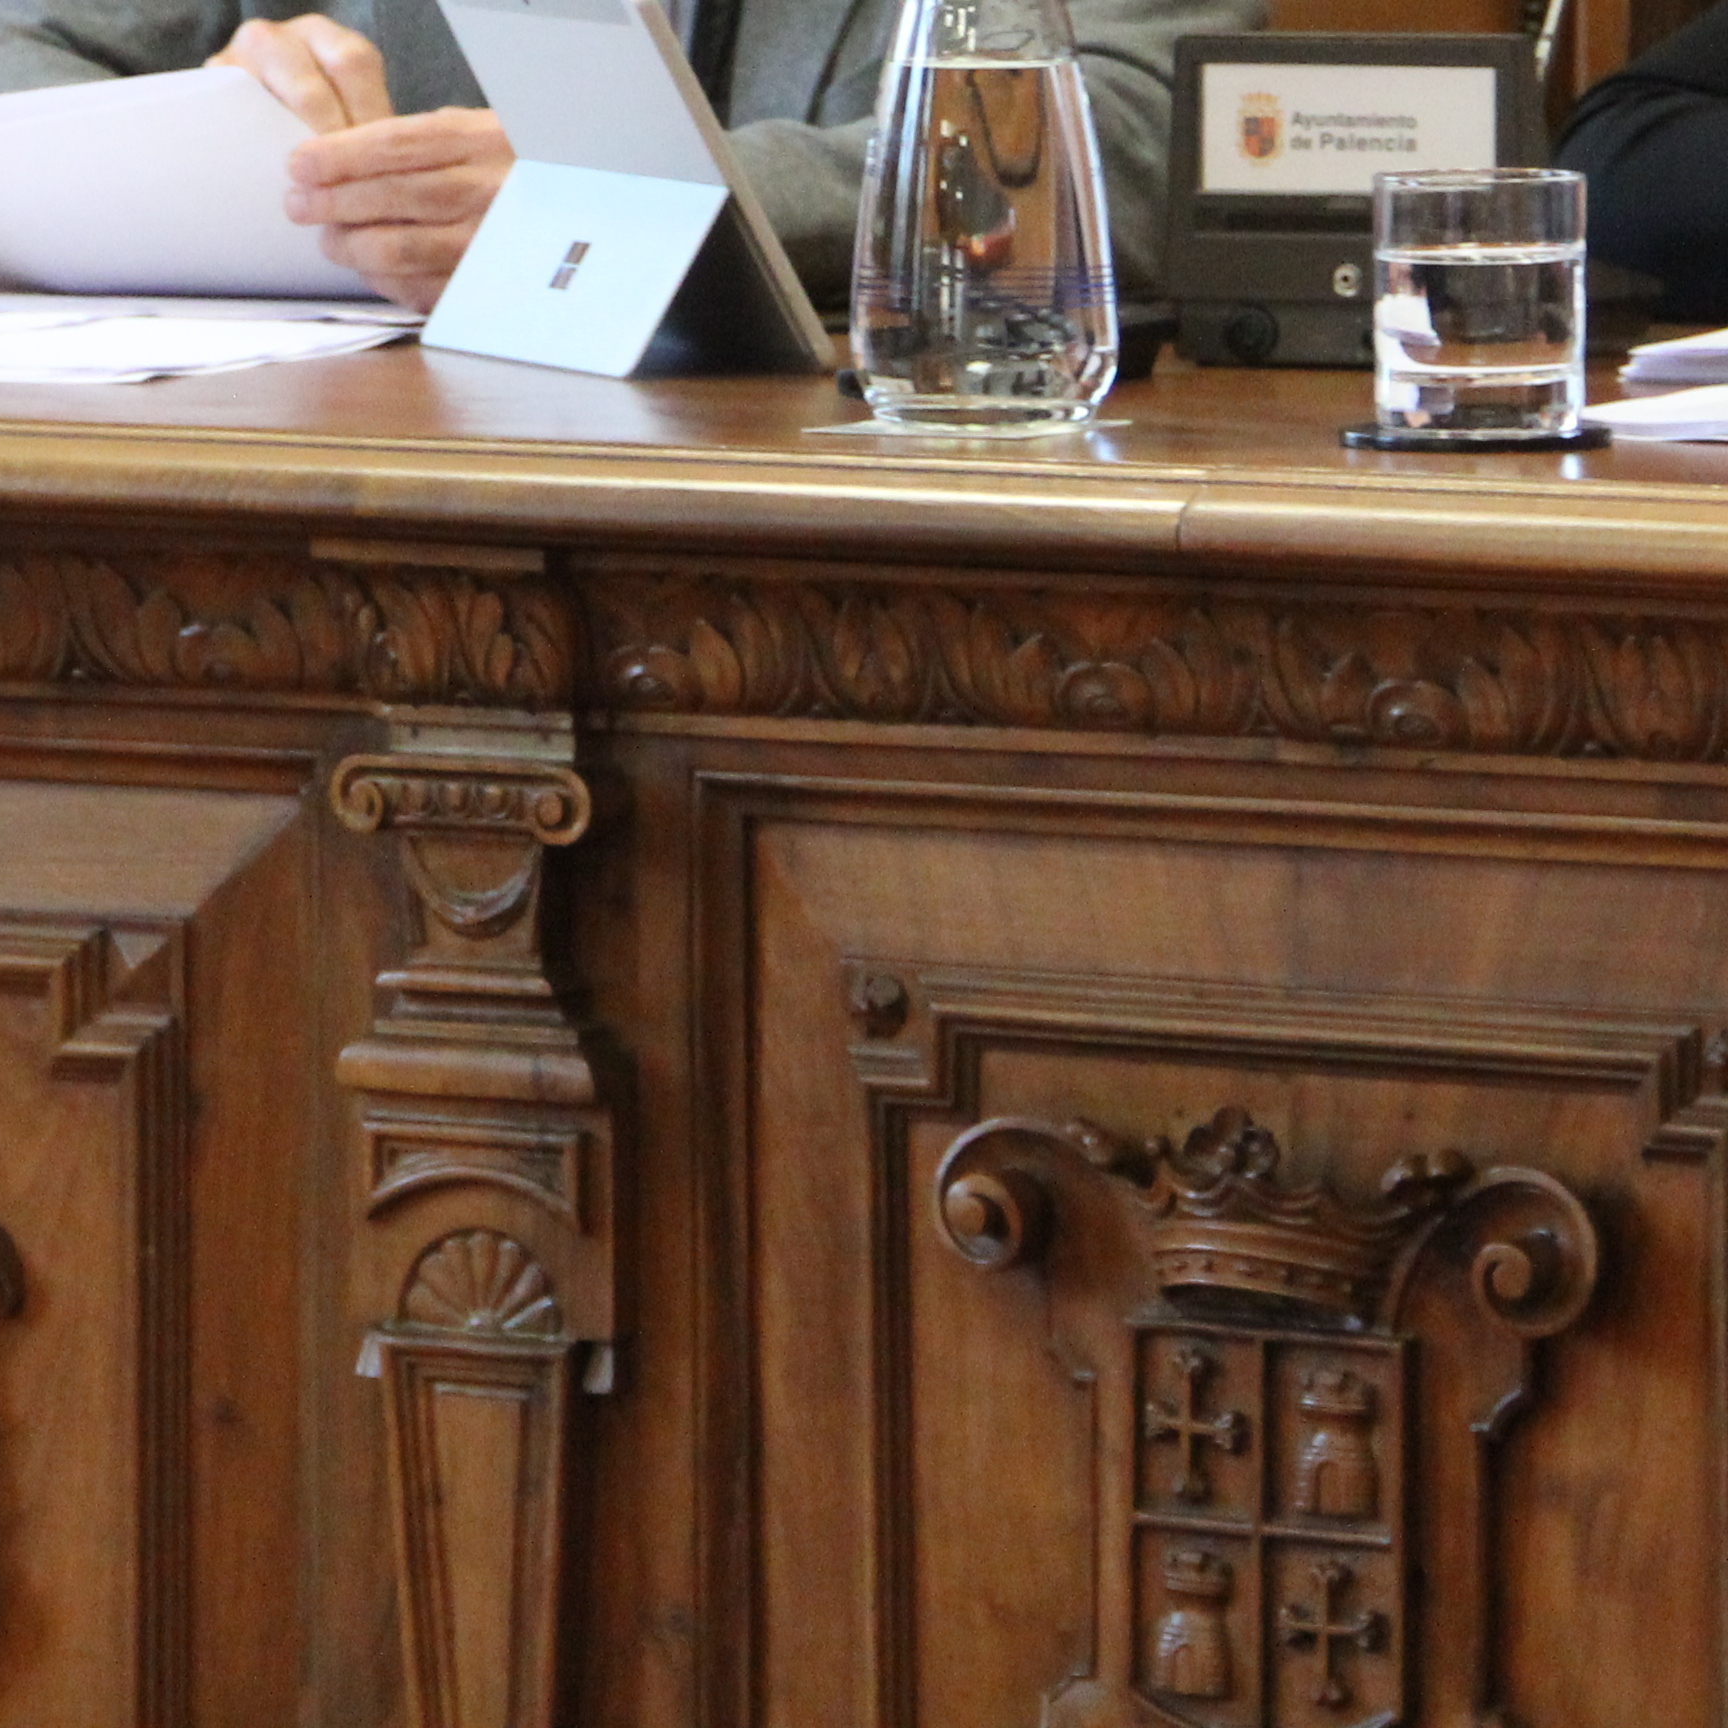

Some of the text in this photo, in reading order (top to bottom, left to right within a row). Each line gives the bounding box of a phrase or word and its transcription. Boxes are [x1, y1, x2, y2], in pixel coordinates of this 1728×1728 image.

[1292, 112, 1418, 130] Ayuntamiento
[1291, 133, 1418, 153] de Palencia
